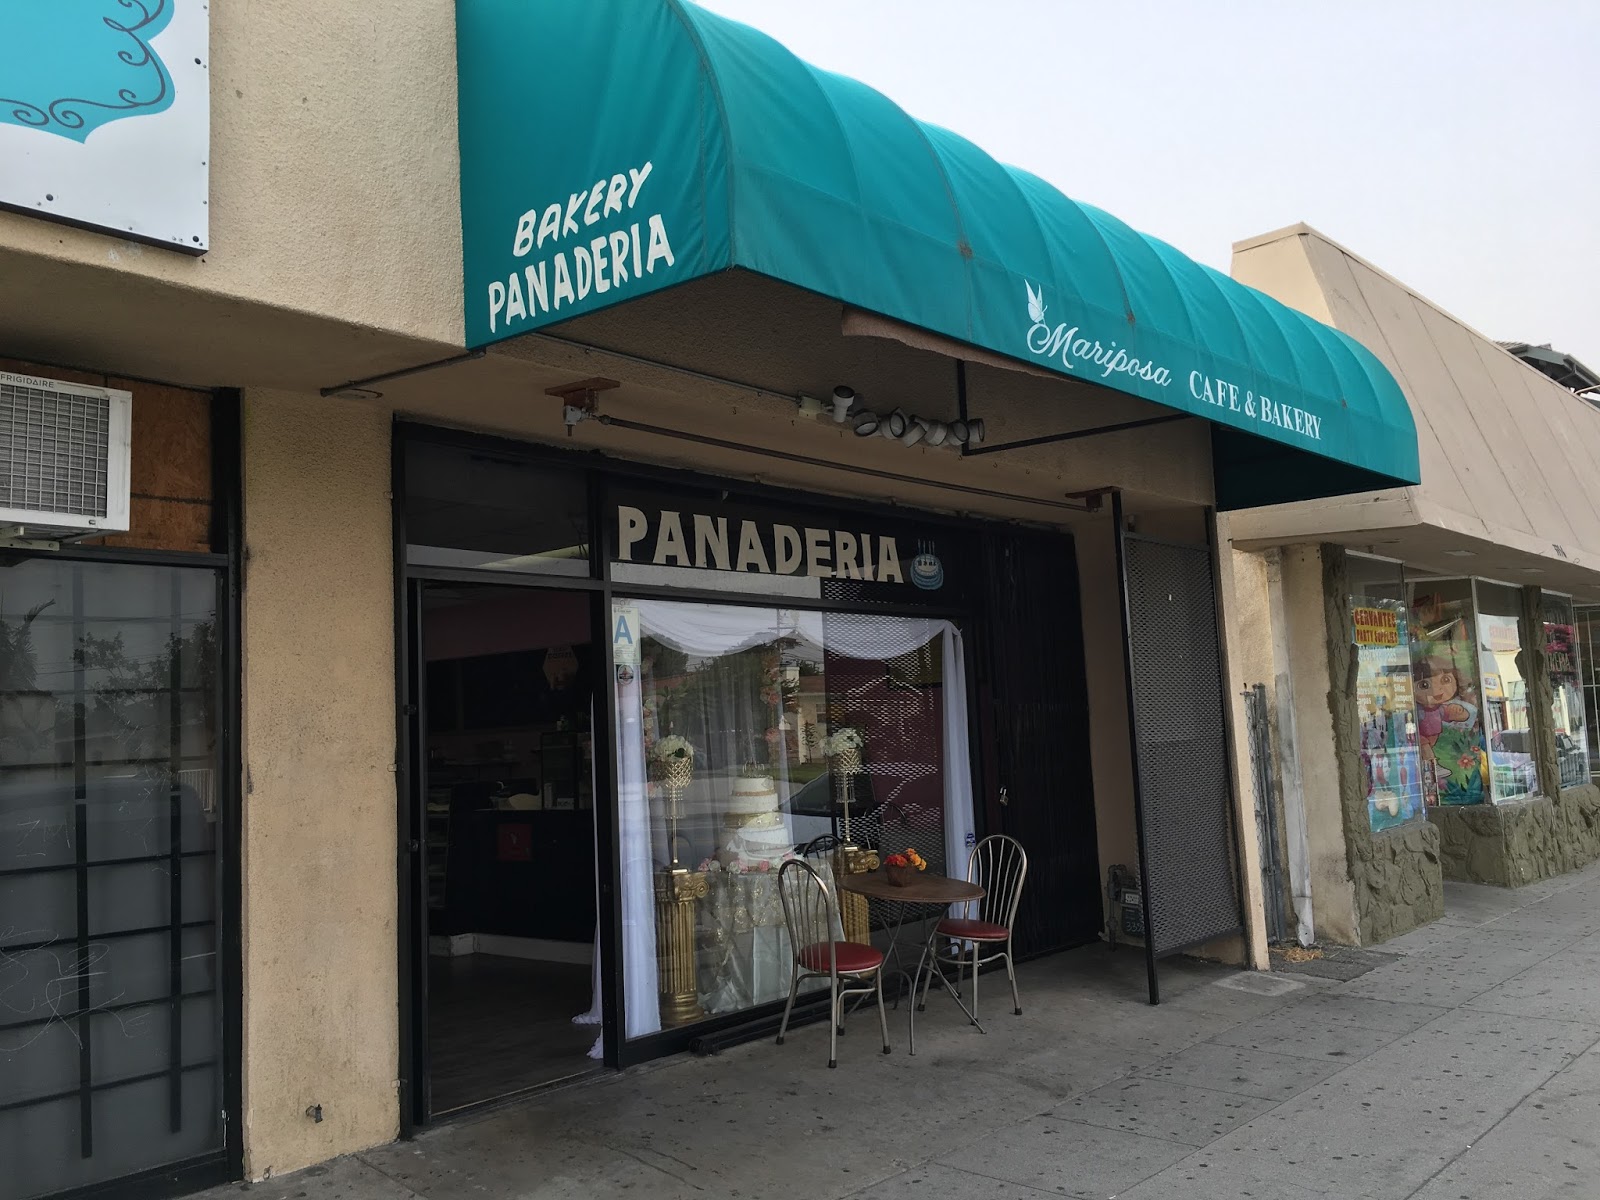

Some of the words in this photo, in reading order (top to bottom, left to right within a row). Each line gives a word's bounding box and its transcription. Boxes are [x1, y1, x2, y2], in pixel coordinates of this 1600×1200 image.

[513, 160, 653, 257] BAKERY
[488, 214, 675, 334] PANADERIA
[0, 373, 54, 388] FRIGIDAIRE
[1026, 322, 1172, 387] Mariposa
[1189, 369, 1242, 413] CAFE
[1244, 391, 1257, 419] &
[1260, 395, 1322, 440] BAKERY
[617, 505, 904, 584] PANADERIA
[613, 615, 633, 645] A
[1354, 609, 1397, 628] CERVANTES
[1356, 629, 1374, 642] PARTY
[1374, 630, 1398, 644] SUPPLIES
